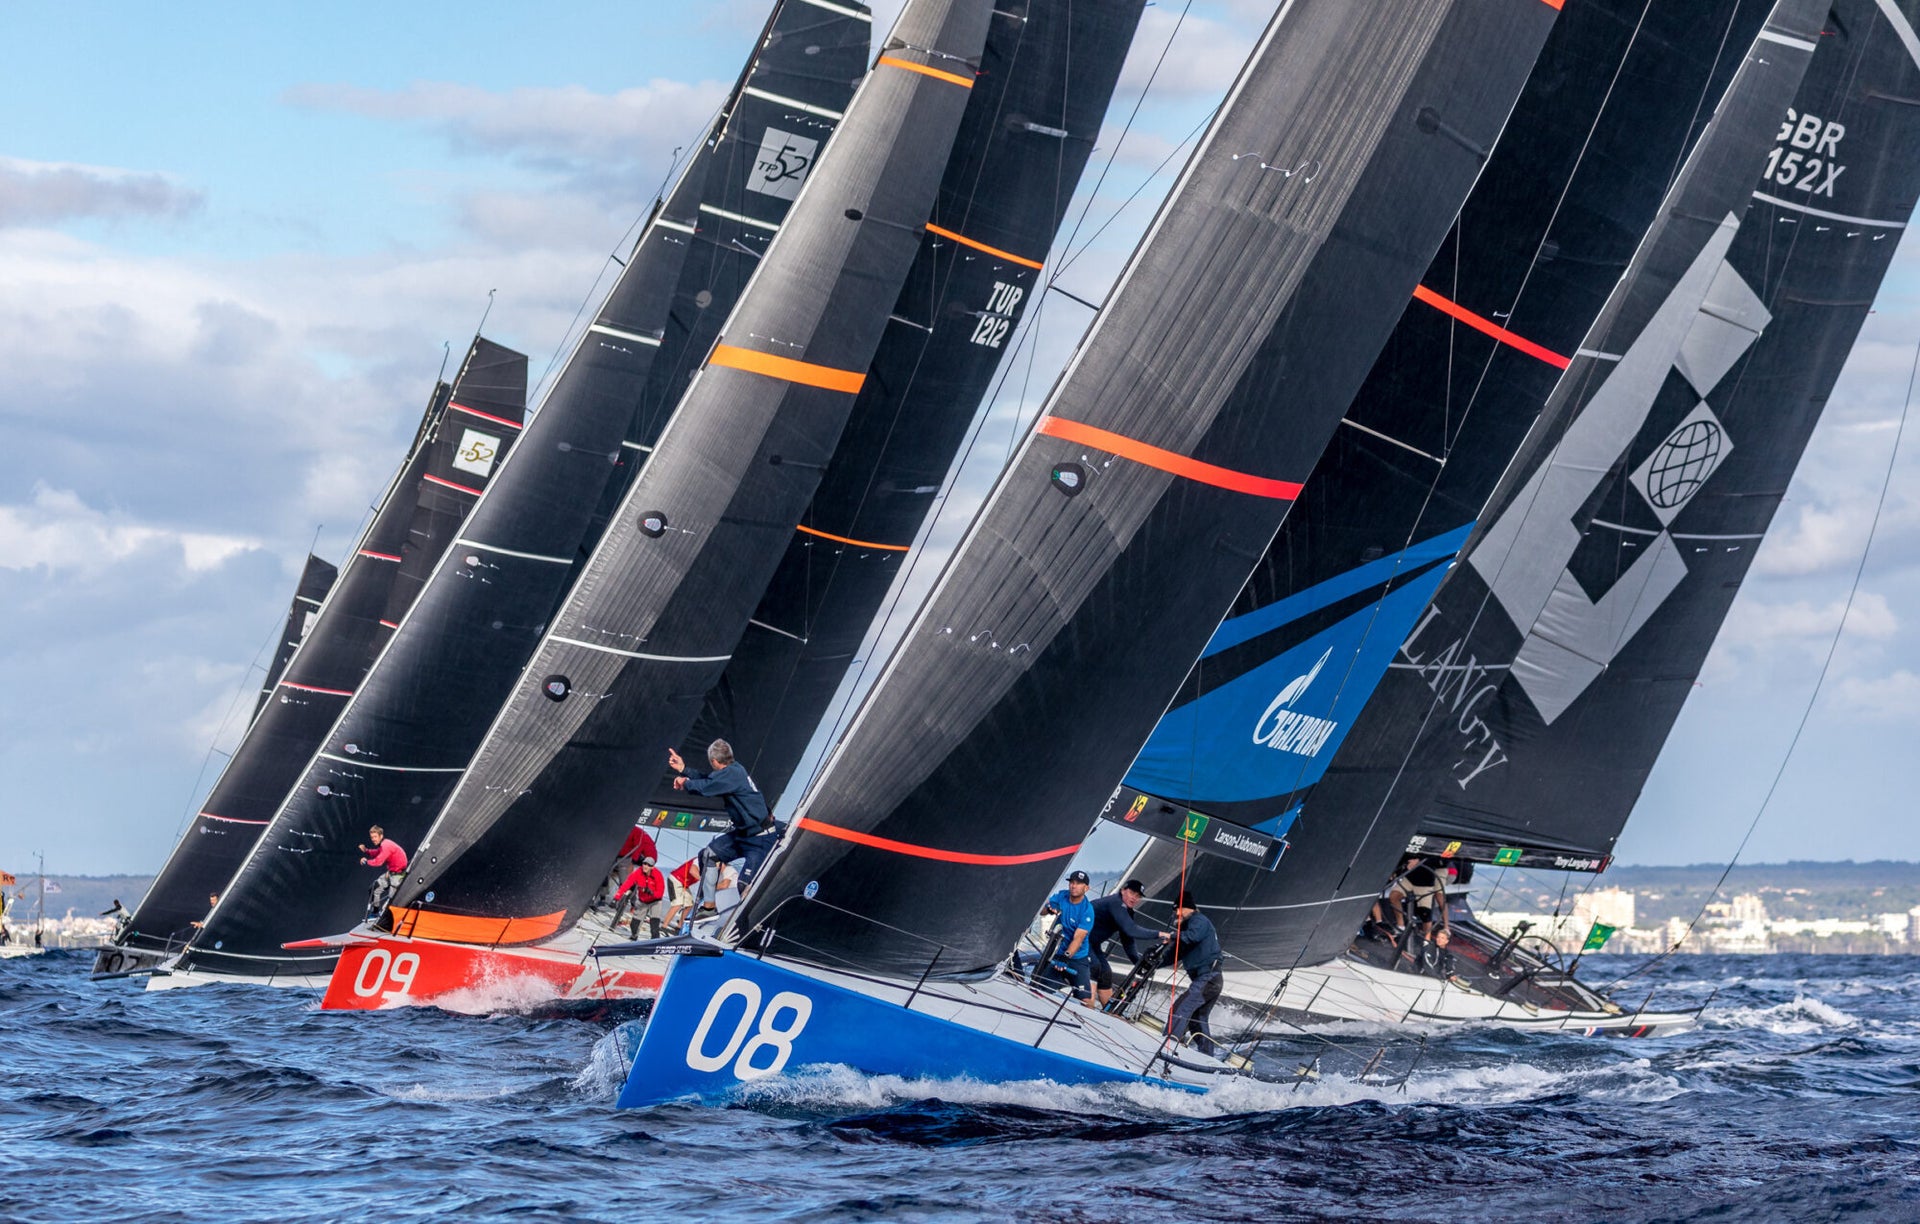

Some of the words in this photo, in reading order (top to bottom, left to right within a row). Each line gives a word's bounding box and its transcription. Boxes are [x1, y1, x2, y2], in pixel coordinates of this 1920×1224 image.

[1776, 107, 1846, 157] GBR
[1763, 146, 1847, 198] 152X
[985, 281, 1024, 317] TUR
[970, 314, 1010, 349] 1212
[353, 948, 421, 1000] 09
[686, 977, 813, 1082] 08
